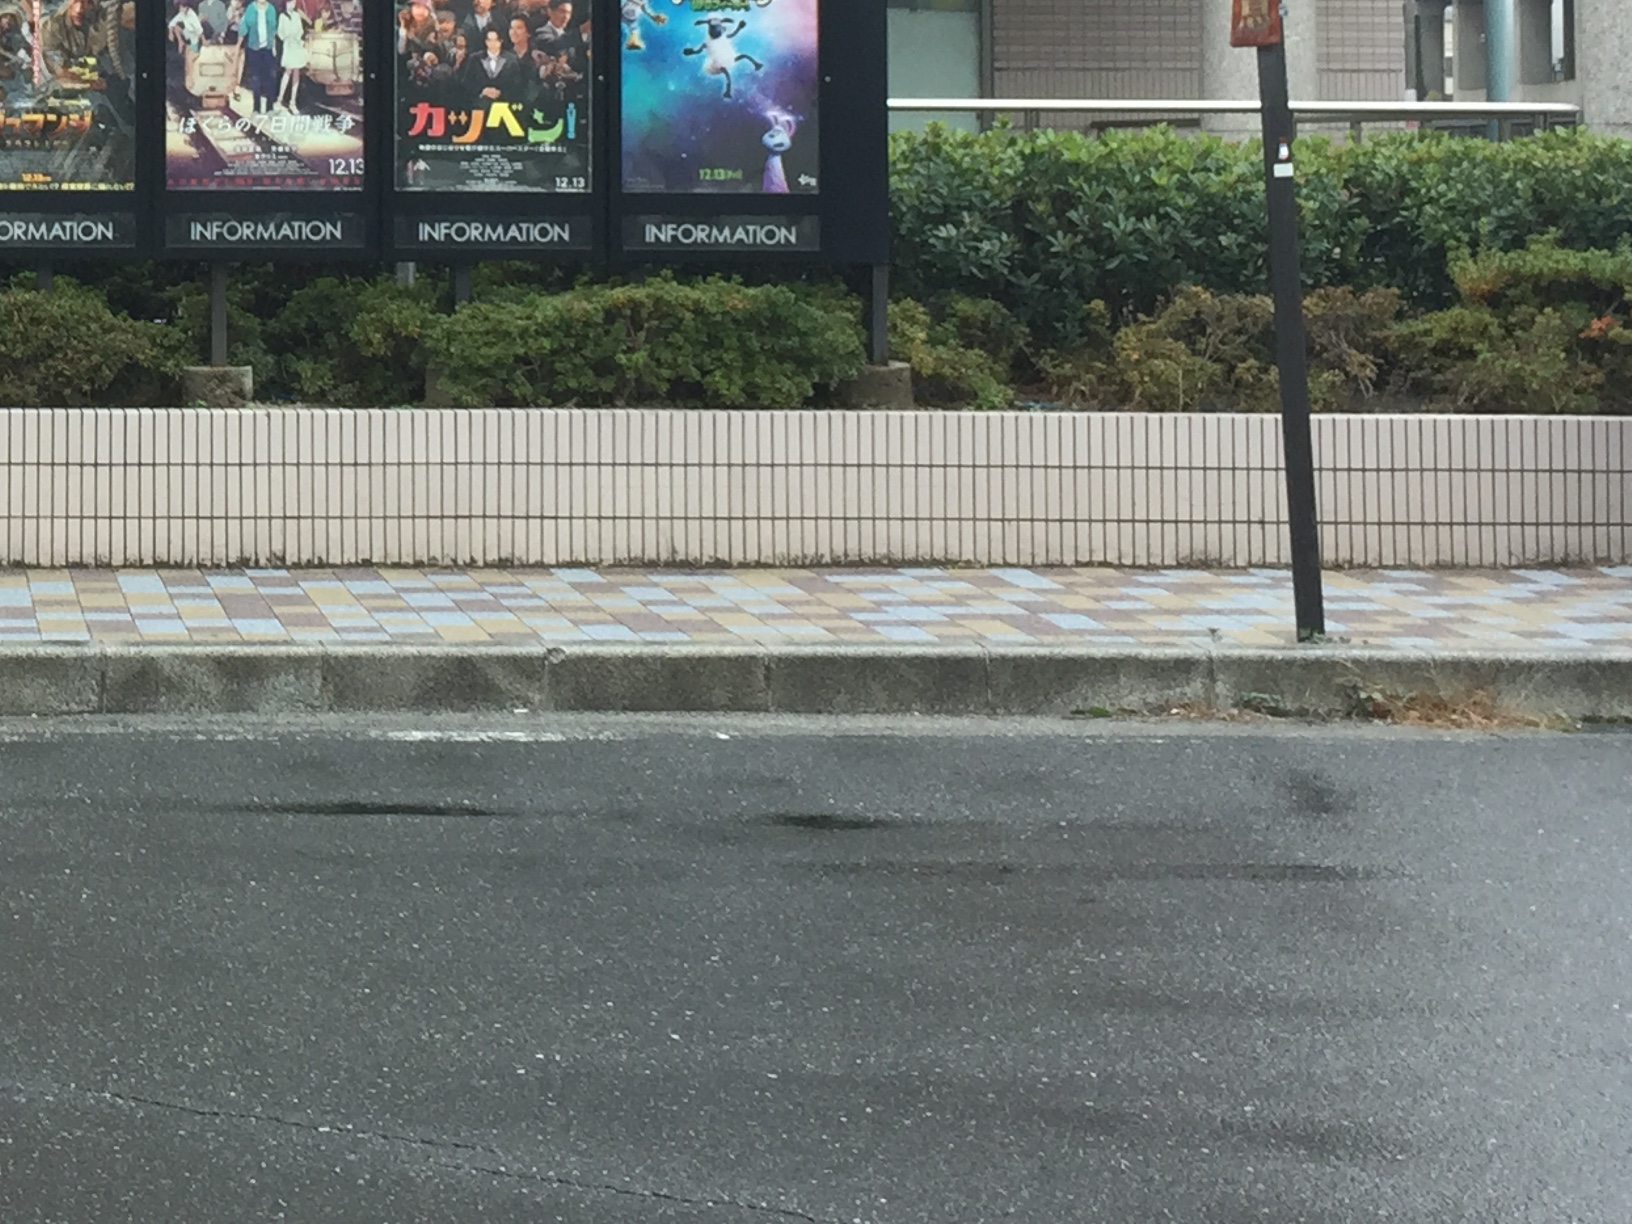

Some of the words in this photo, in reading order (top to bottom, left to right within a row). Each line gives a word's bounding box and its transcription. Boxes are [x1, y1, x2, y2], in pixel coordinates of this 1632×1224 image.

[179, 113, 356, 134] ぼくらの7日間戦争
[555, 177, 585, 188] 12.13
[190, 220, 342, 241] INFORMATION
[418, 222, 570, 243] INFORMATION
[645, 223, 797, 245] INFORMATION
